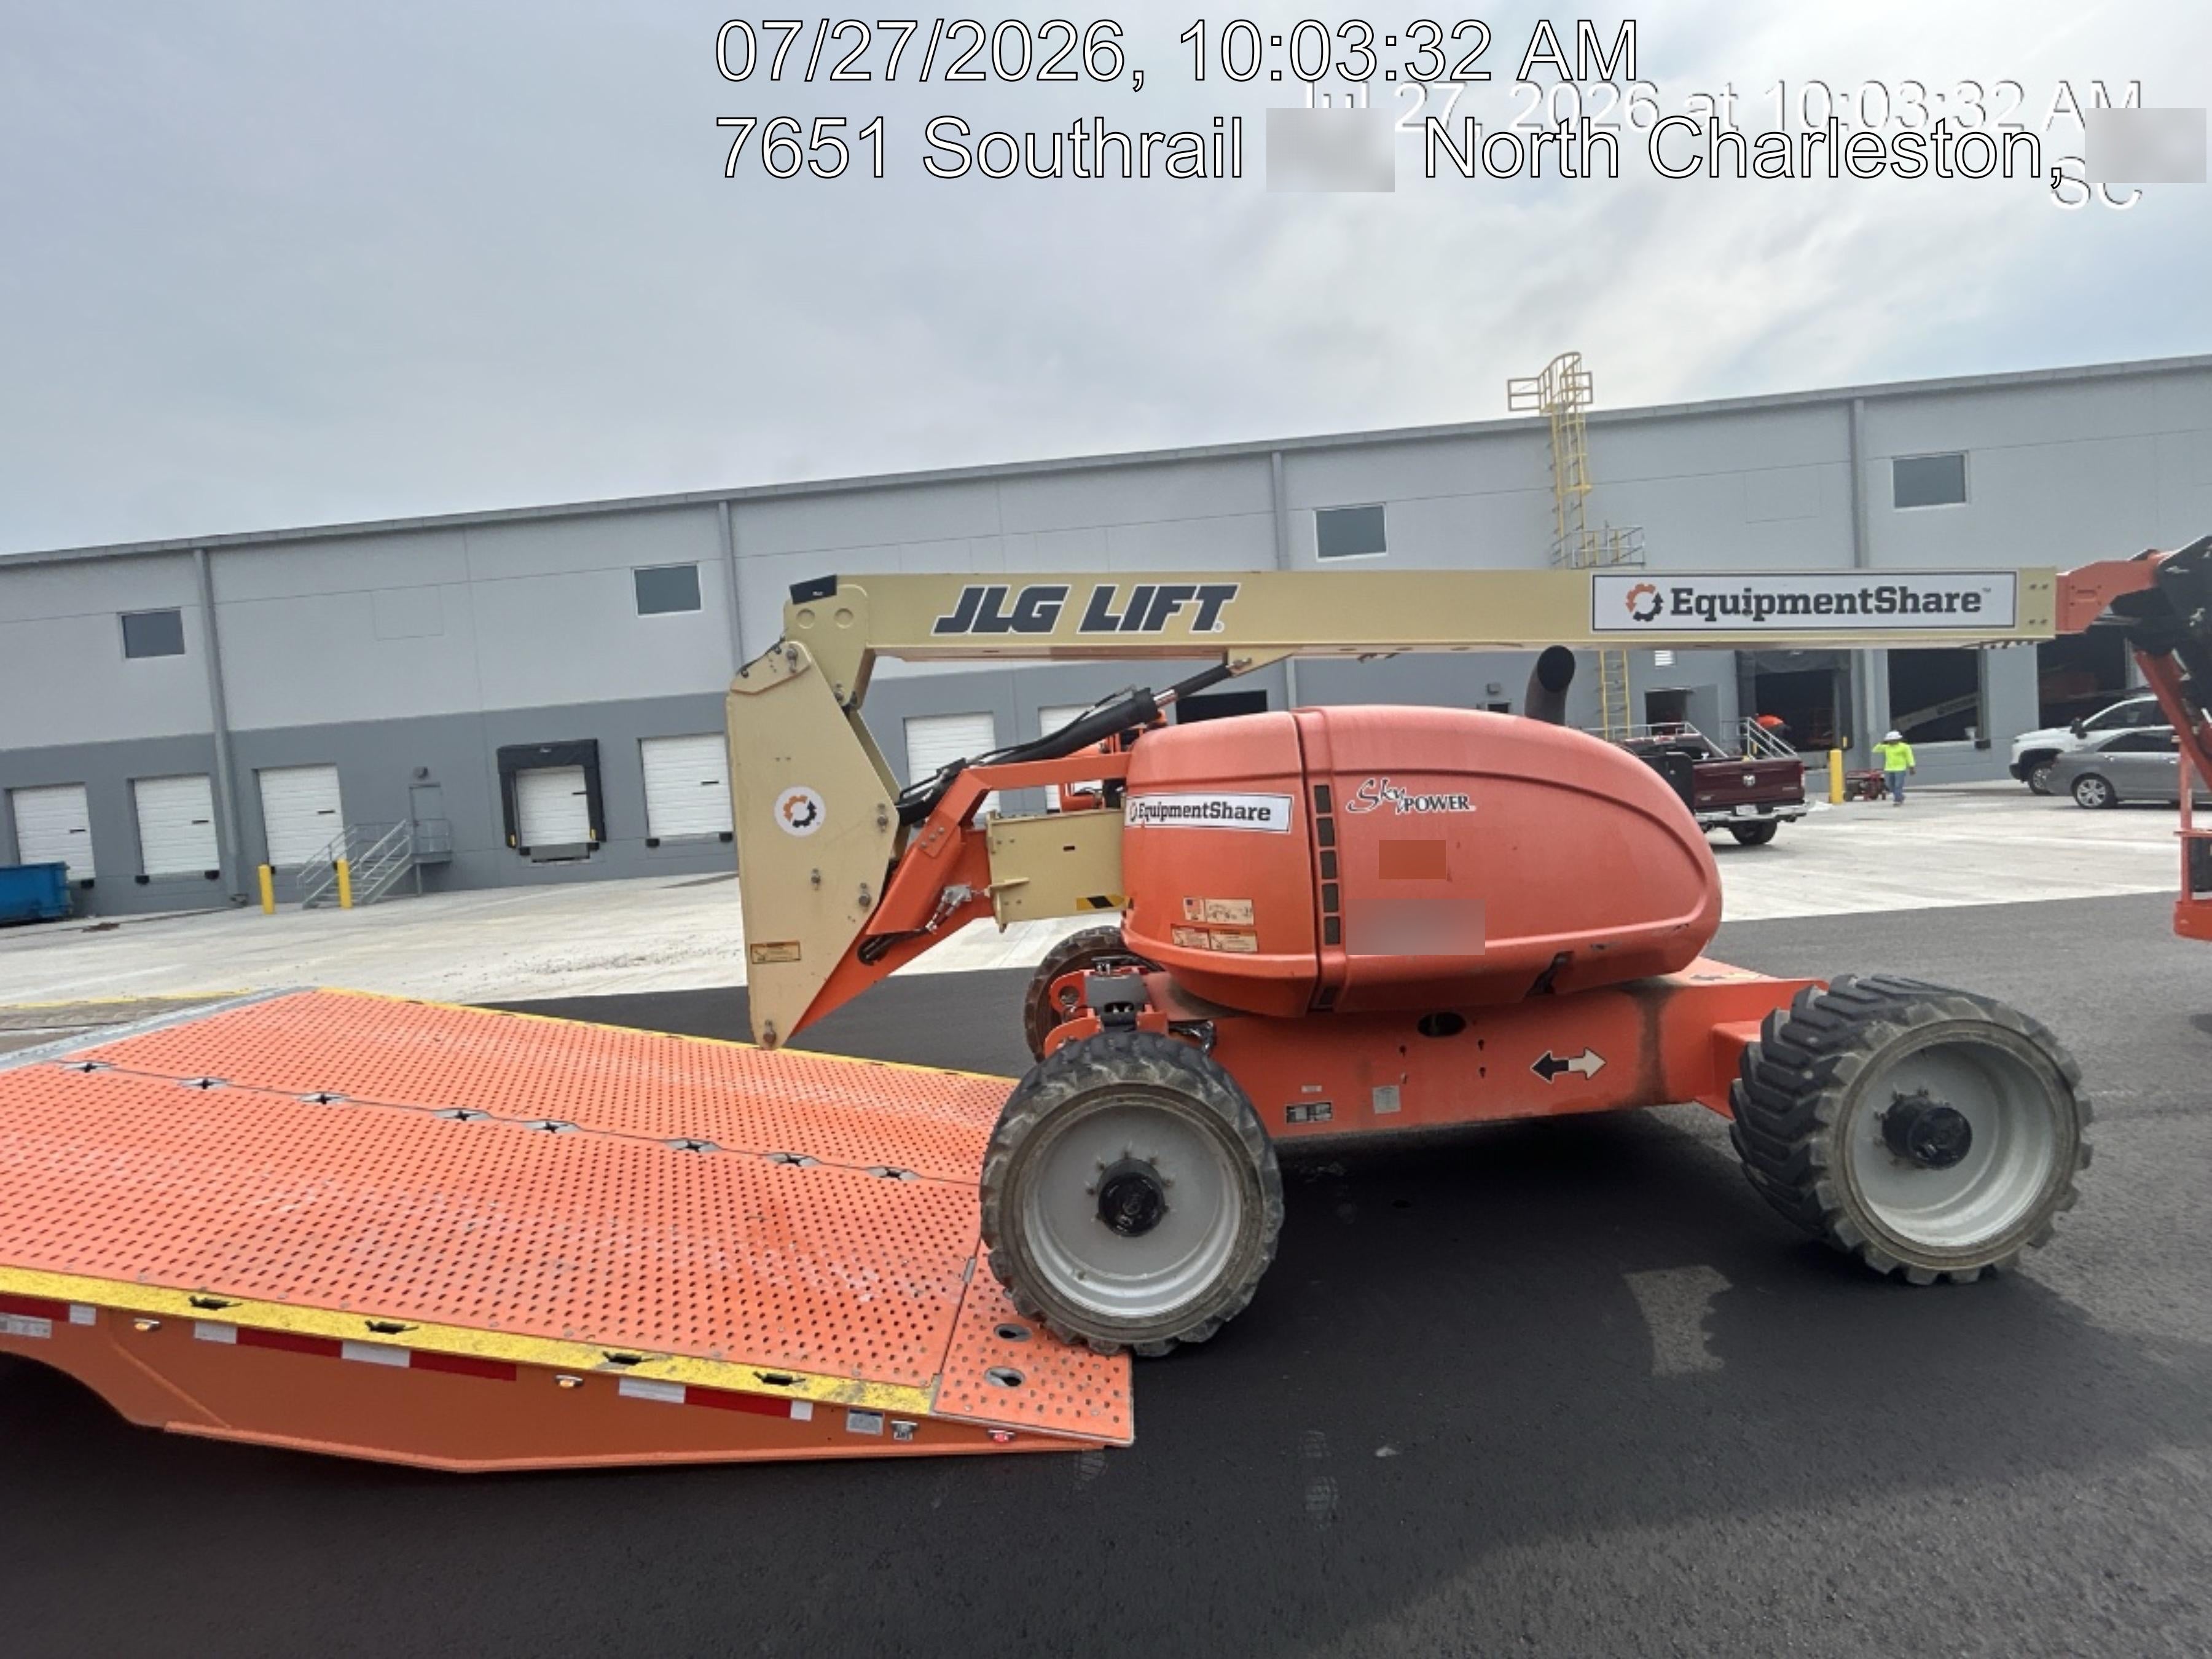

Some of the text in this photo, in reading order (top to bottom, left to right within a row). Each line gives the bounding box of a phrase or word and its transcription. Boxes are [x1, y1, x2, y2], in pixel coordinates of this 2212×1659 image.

[931, 582, 1241, 635] JLG LIFT
[1138, 801, 1271, 822] EquipmentShare
